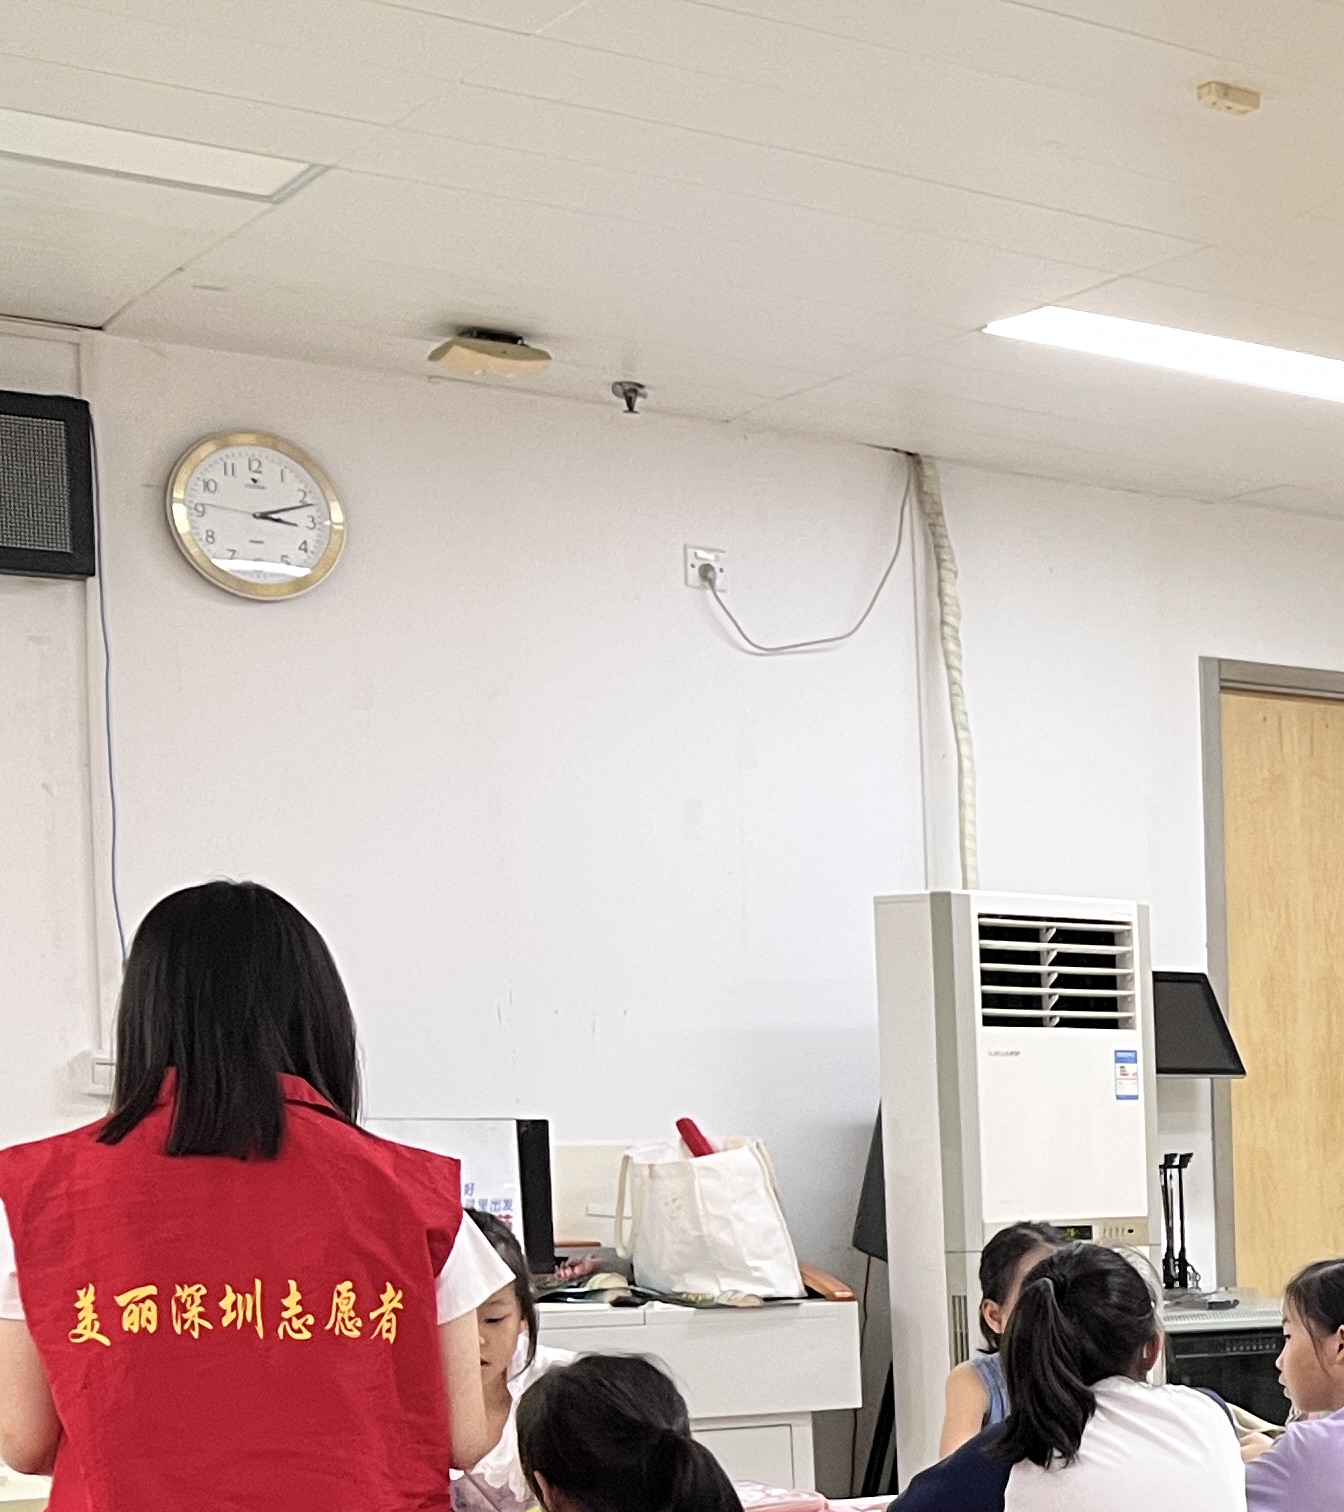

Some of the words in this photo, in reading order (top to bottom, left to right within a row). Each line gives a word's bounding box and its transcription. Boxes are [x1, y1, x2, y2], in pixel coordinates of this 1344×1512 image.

[223, 461, 235, 476] 11
[248, 457, 263, 474] 12
[202, 478, 218, 493] 10
[193, 503, 206, 518] 9
[305, 515, 317, 531] 3
[204, 529, 216, 545] 8
[297, 539, 309, 553] 4
[68, 1278, 404, 1347] 美丽深圳志愿者
